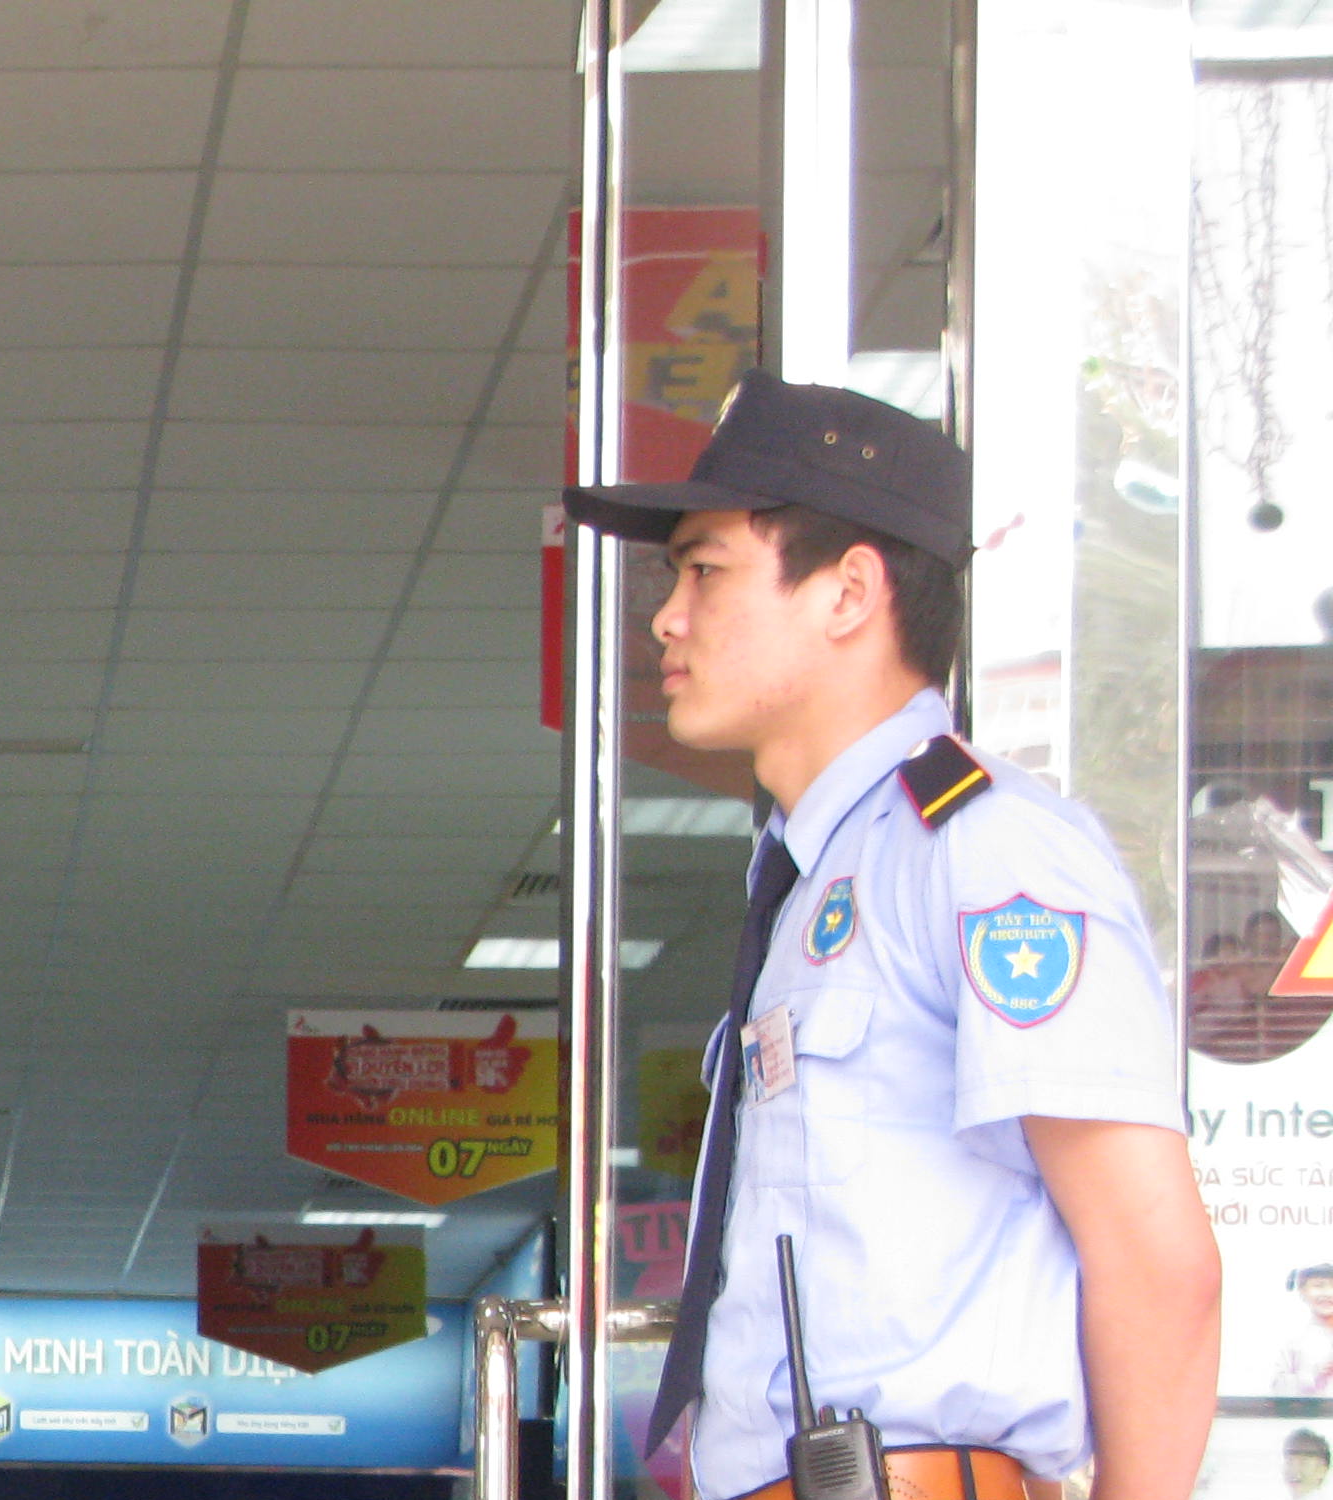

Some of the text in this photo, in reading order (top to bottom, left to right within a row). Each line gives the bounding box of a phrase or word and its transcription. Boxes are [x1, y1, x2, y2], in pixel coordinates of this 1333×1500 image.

[427, 1137, 486, 1178] 07
[3, 1338, 103, 1376] MINH
[117, 1334, 212, 1378] TOÀN
